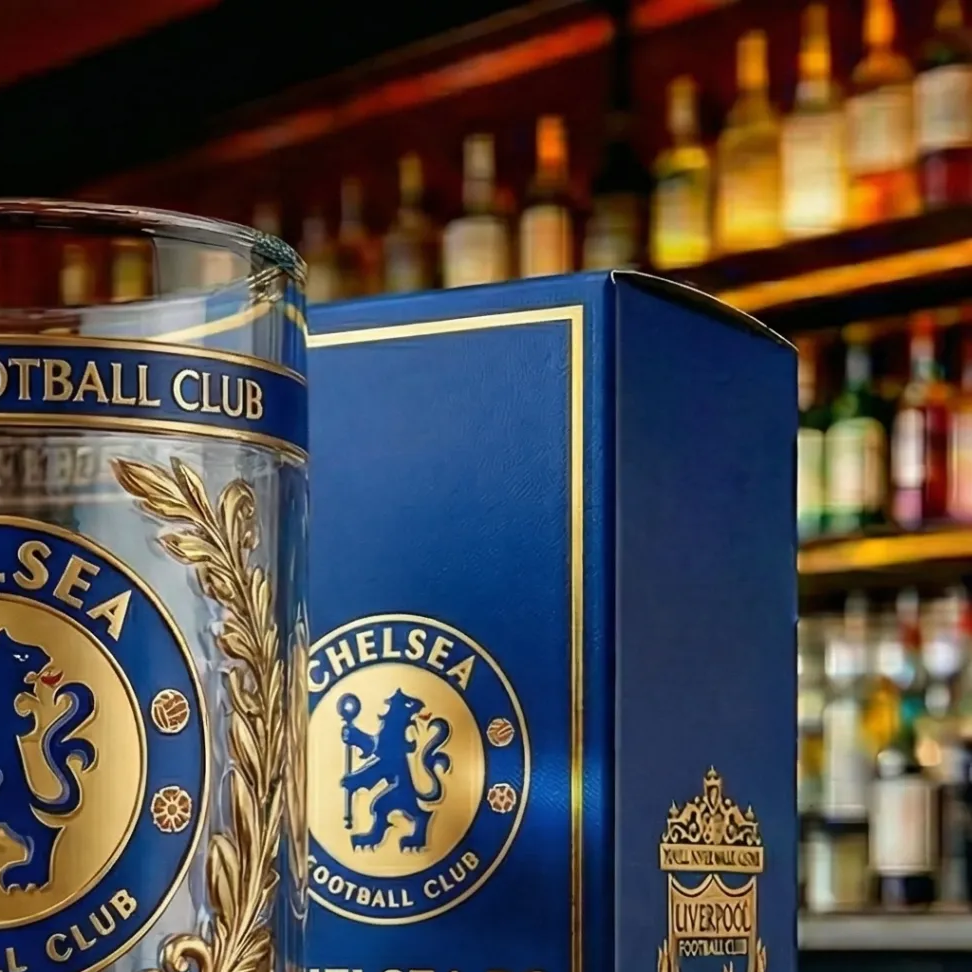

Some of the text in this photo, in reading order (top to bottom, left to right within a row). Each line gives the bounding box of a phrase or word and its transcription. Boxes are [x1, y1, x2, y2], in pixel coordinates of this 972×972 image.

[172, 369, 265, 421] CLUB
[308, 627, 478, 692] CHELSEA
[424, 851, 481, 899] CLUB
[46, 888, 139, 961] CLUB
